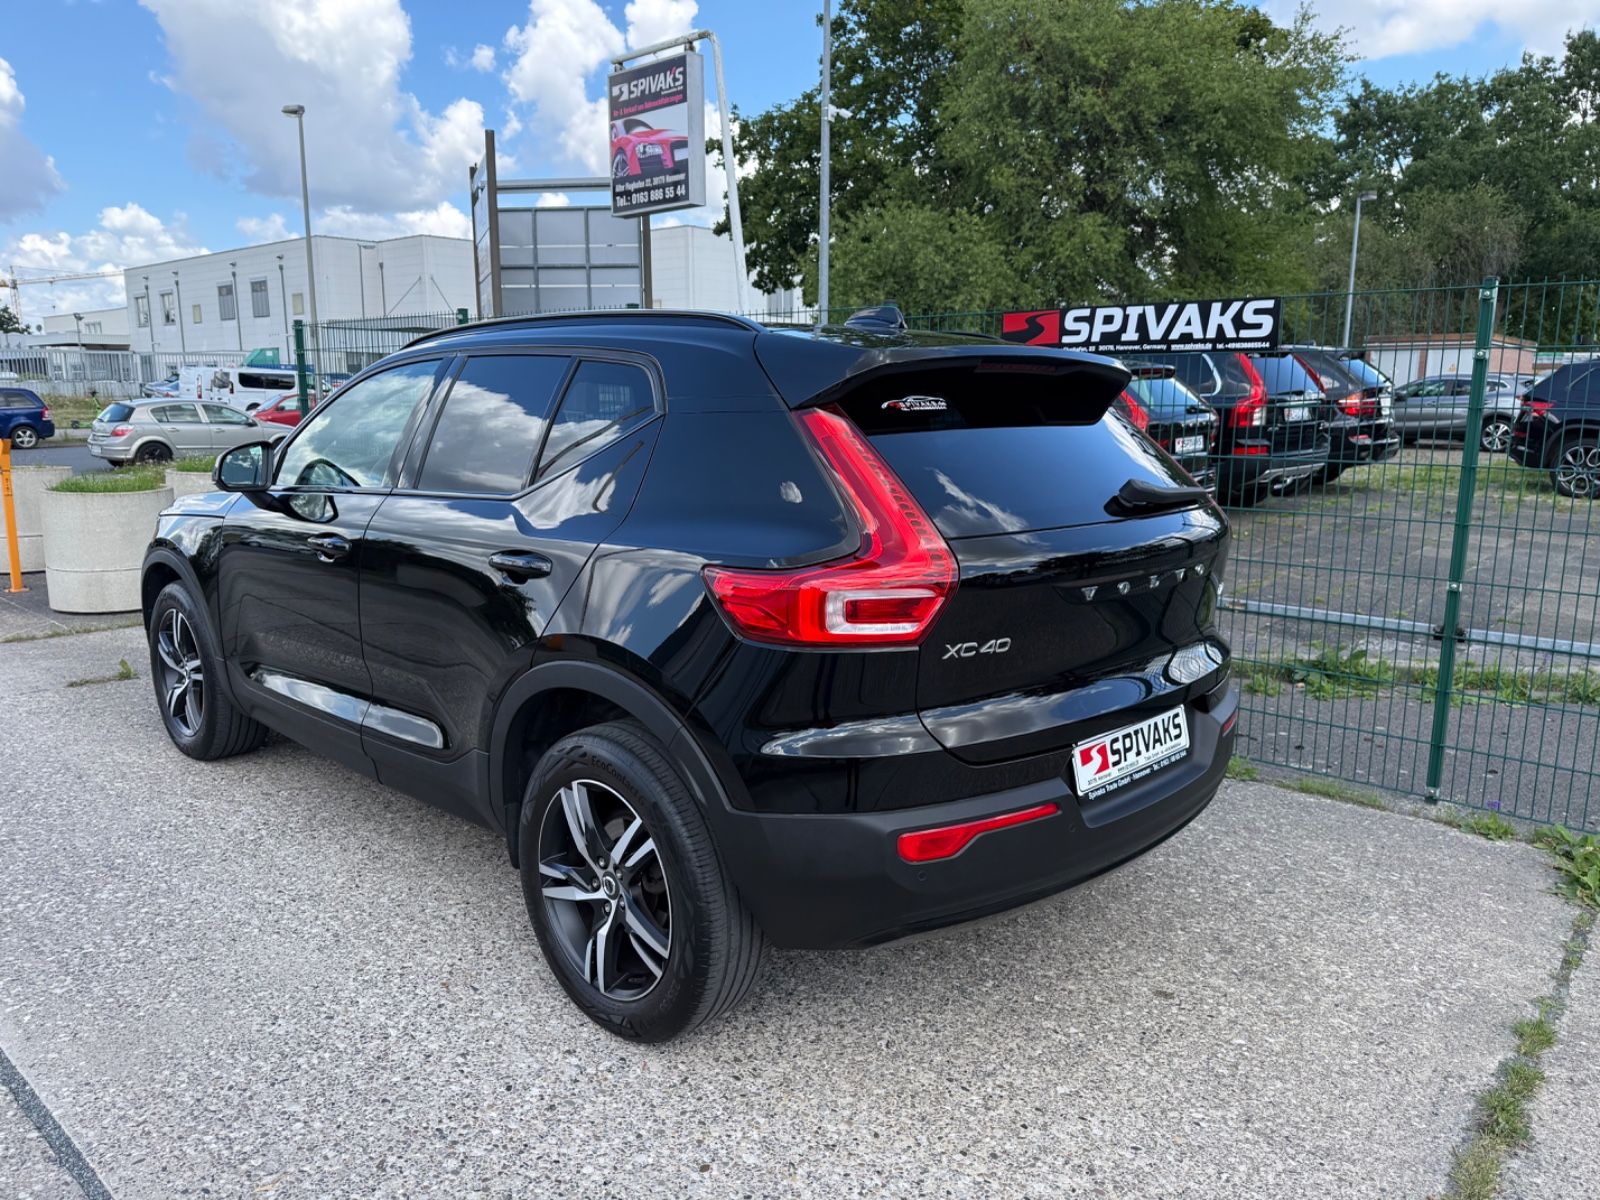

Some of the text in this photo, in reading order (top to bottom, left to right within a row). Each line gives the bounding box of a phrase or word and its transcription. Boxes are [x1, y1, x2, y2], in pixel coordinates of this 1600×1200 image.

[616, 195, 631, 207] Tel.:
[631, 191, 649, 204] 0163
[664, 185, 675, 199] 55
[676, 183, 686, 197] 44
[1061, 299, 1275, 344] SPIVAKS
[1115, 343, 1142, 351] Hannover,
[1142, 343, 1167, 351] Germany
[1081, 563, 1206, 601] VOLVO
[1109, 712, 1182, 768] SPIVAKS
